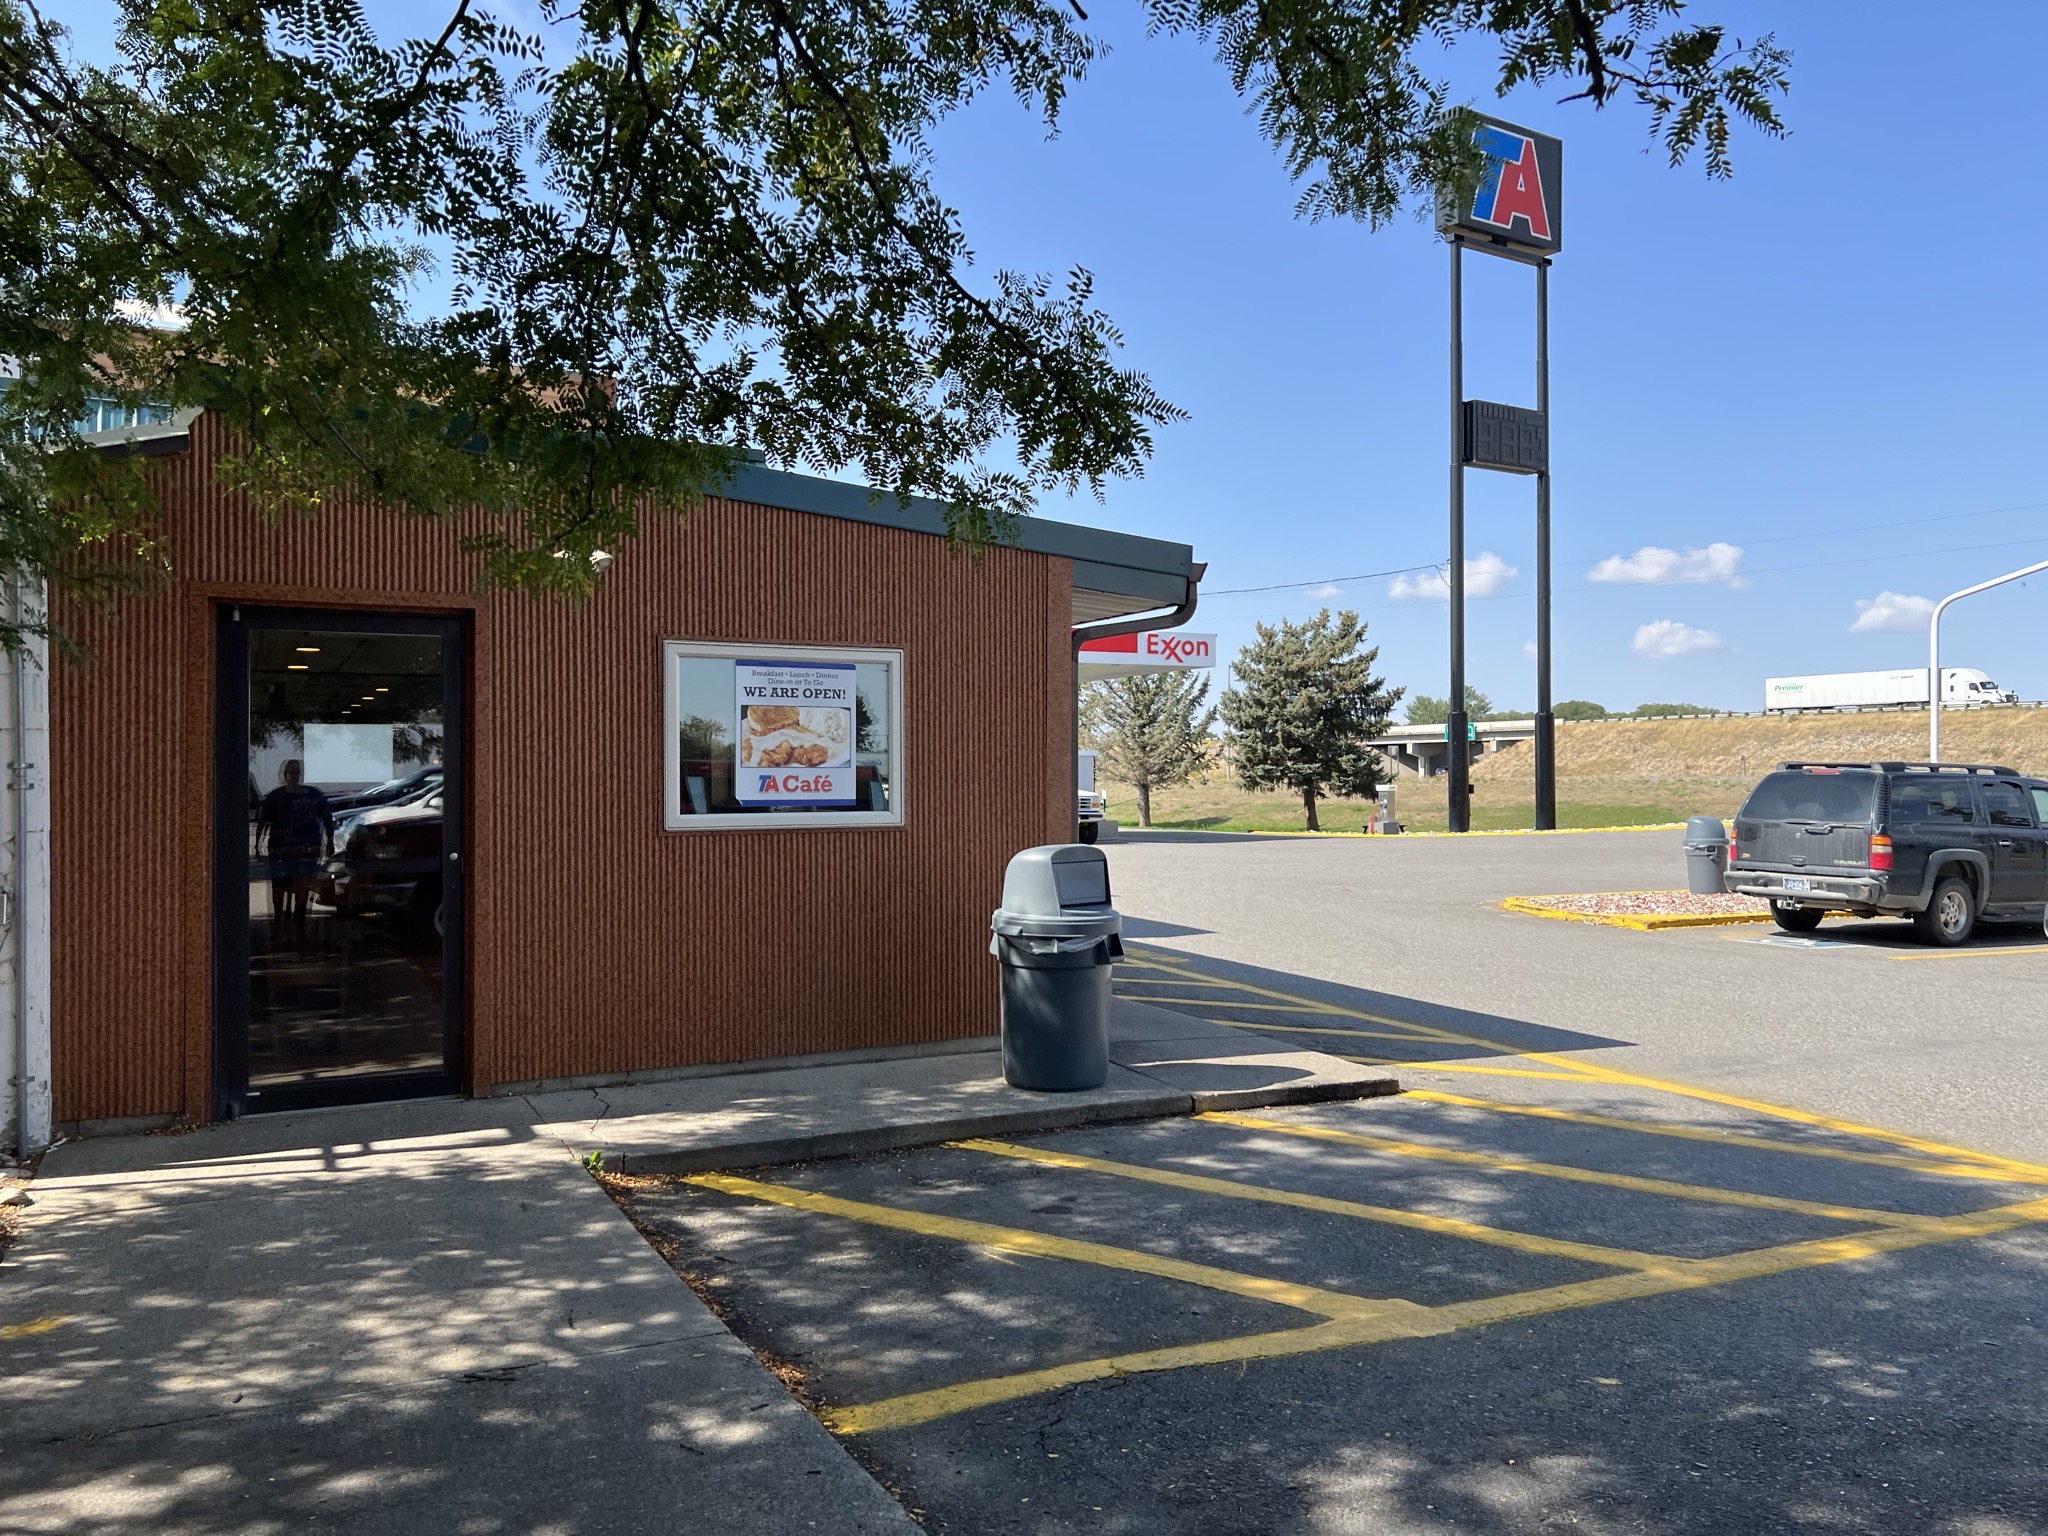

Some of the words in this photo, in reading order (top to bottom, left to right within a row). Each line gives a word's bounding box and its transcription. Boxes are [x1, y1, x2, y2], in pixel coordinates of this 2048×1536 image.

[1471, 123, 1552, 241] TA
[1147, 633, 1209, 663] Exxon
[751, 669, 784, 677] Breakfast
[743, 686, 767, 698] WE
[770, 687, 799, 698] ARE
[802, 688, 846, 700] OPEN!
[1774, 684, 1805, 692] Premier
[758, 774, 780, 793] TA
[782, 774, 833, 793] Café
